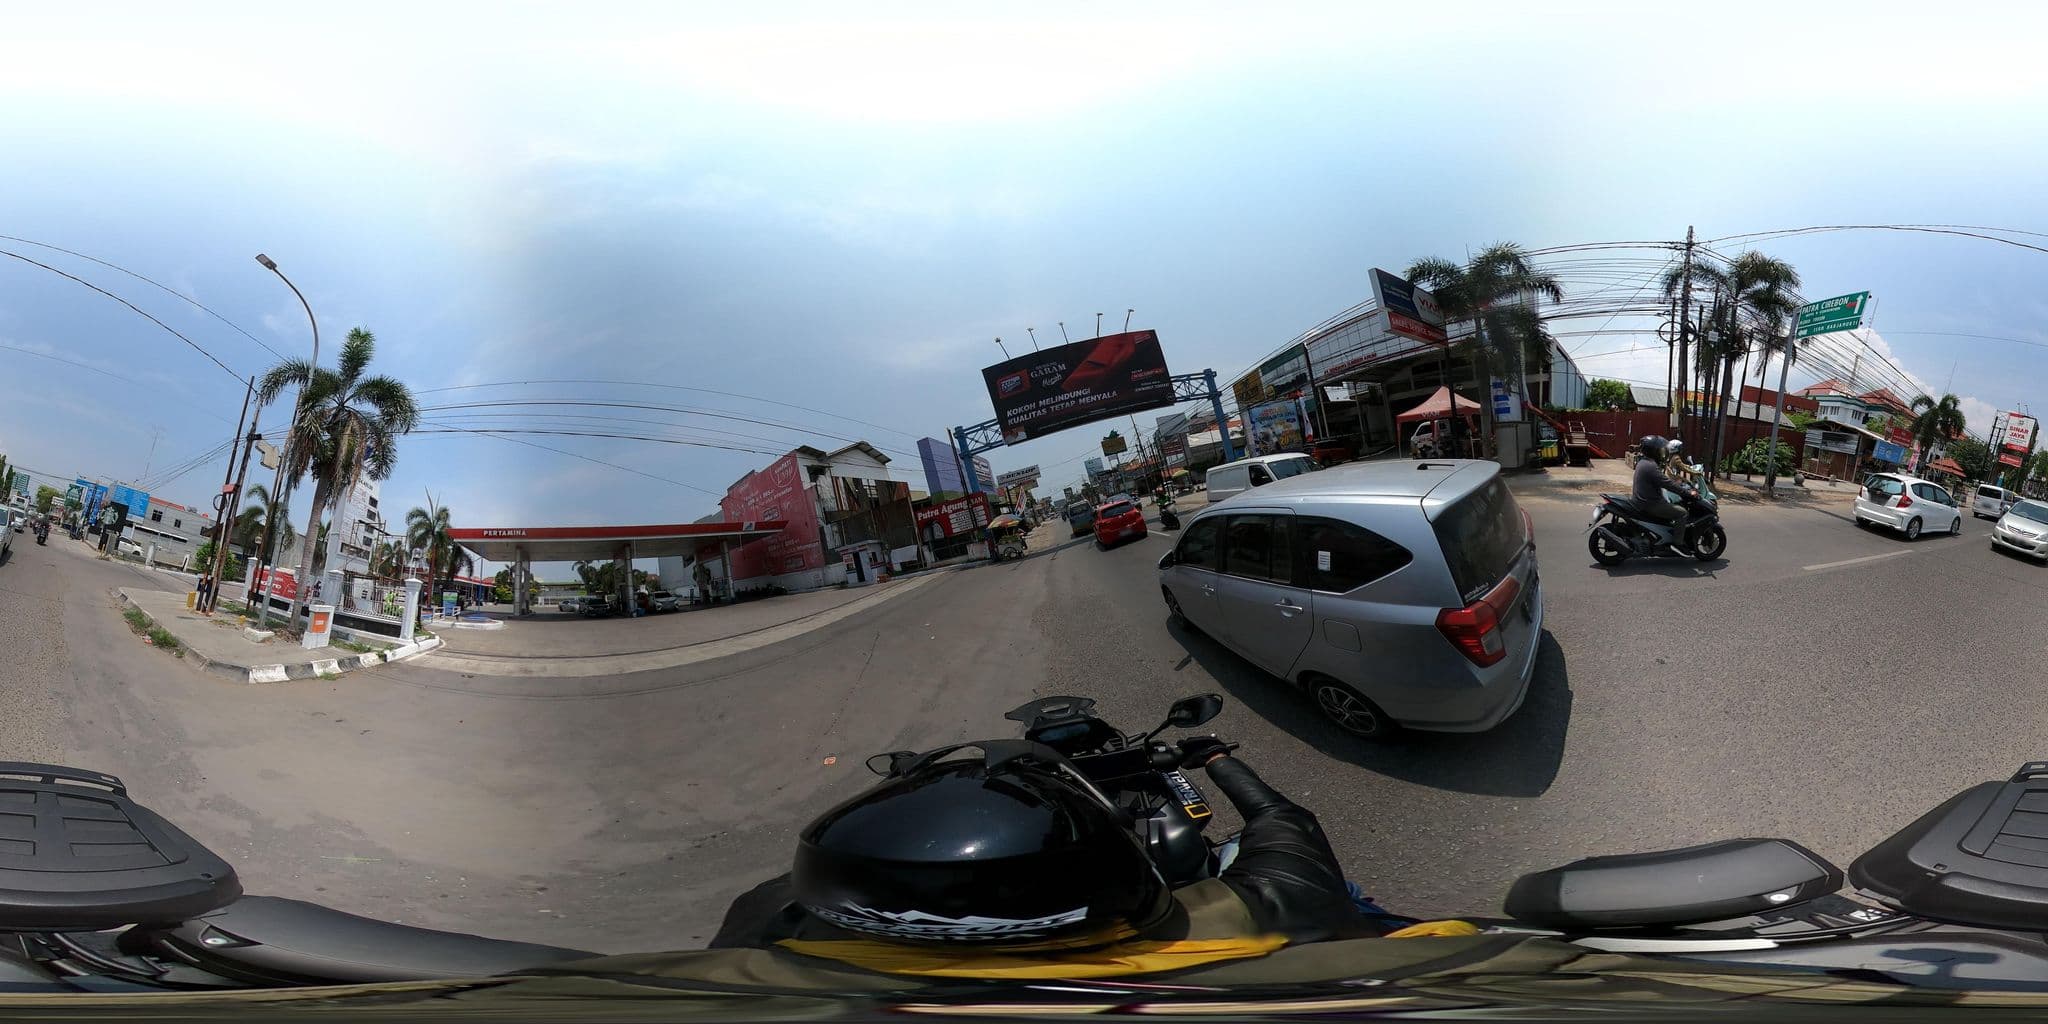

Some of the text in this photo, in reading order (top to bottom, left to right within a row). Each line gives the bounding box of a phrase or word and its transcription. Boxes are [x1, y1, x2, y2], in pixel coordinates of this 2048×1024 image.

[1821, 296, 1850, 309] CIREBON
[1030, 363, 1067, 378] GARAM
[1006, 387, 1091, 417] KOKOH MELINDUNGI
[1008, 390, 1118, 426] KUALITAS TETAP MENYALA
[2009, 432, 2025, 440] JAYA
[1005, 467, 1036, 479] DUNLOP
[941, 500, 968, 515] Agung
[483, 528, 527, 537] PERTAMINA
